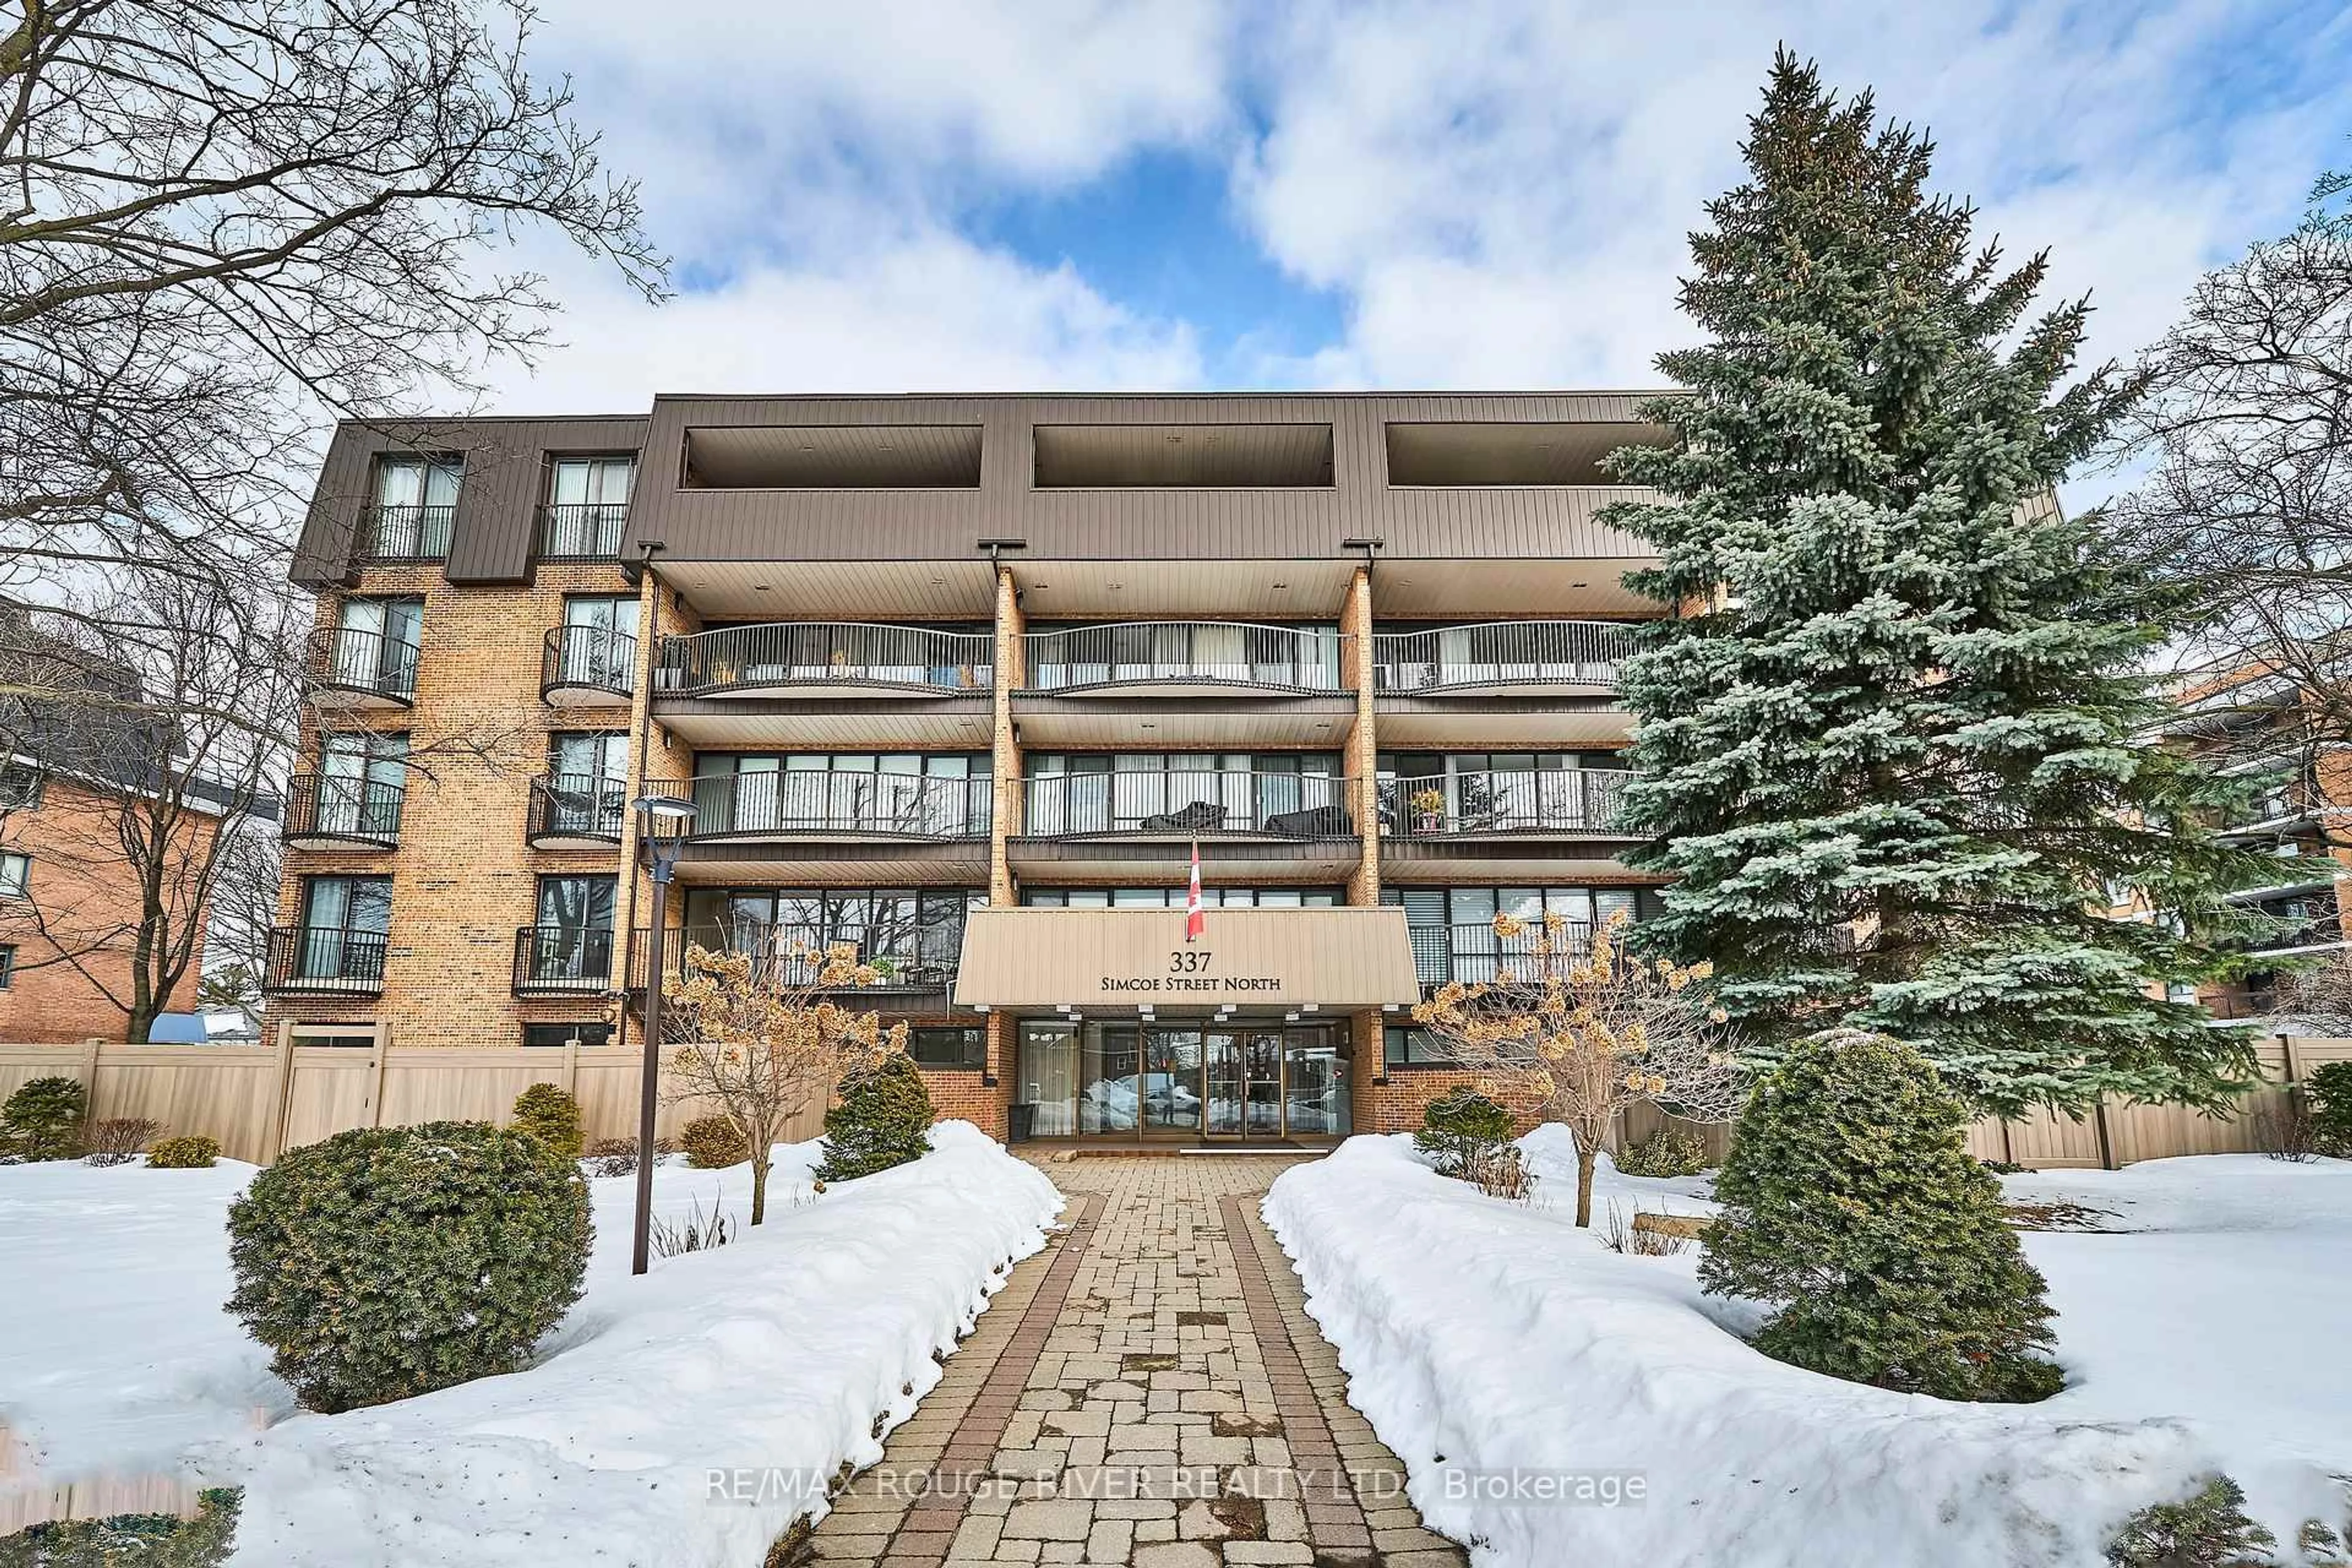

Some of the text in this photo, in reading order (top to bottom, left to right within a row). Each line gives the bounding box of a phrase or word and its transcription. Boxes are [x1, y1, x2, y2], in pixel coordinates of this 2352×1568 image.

[1170, 951, 1212, 973] 337
[1101, 977, 1281, 991] SIMCOE STREET NORTH
